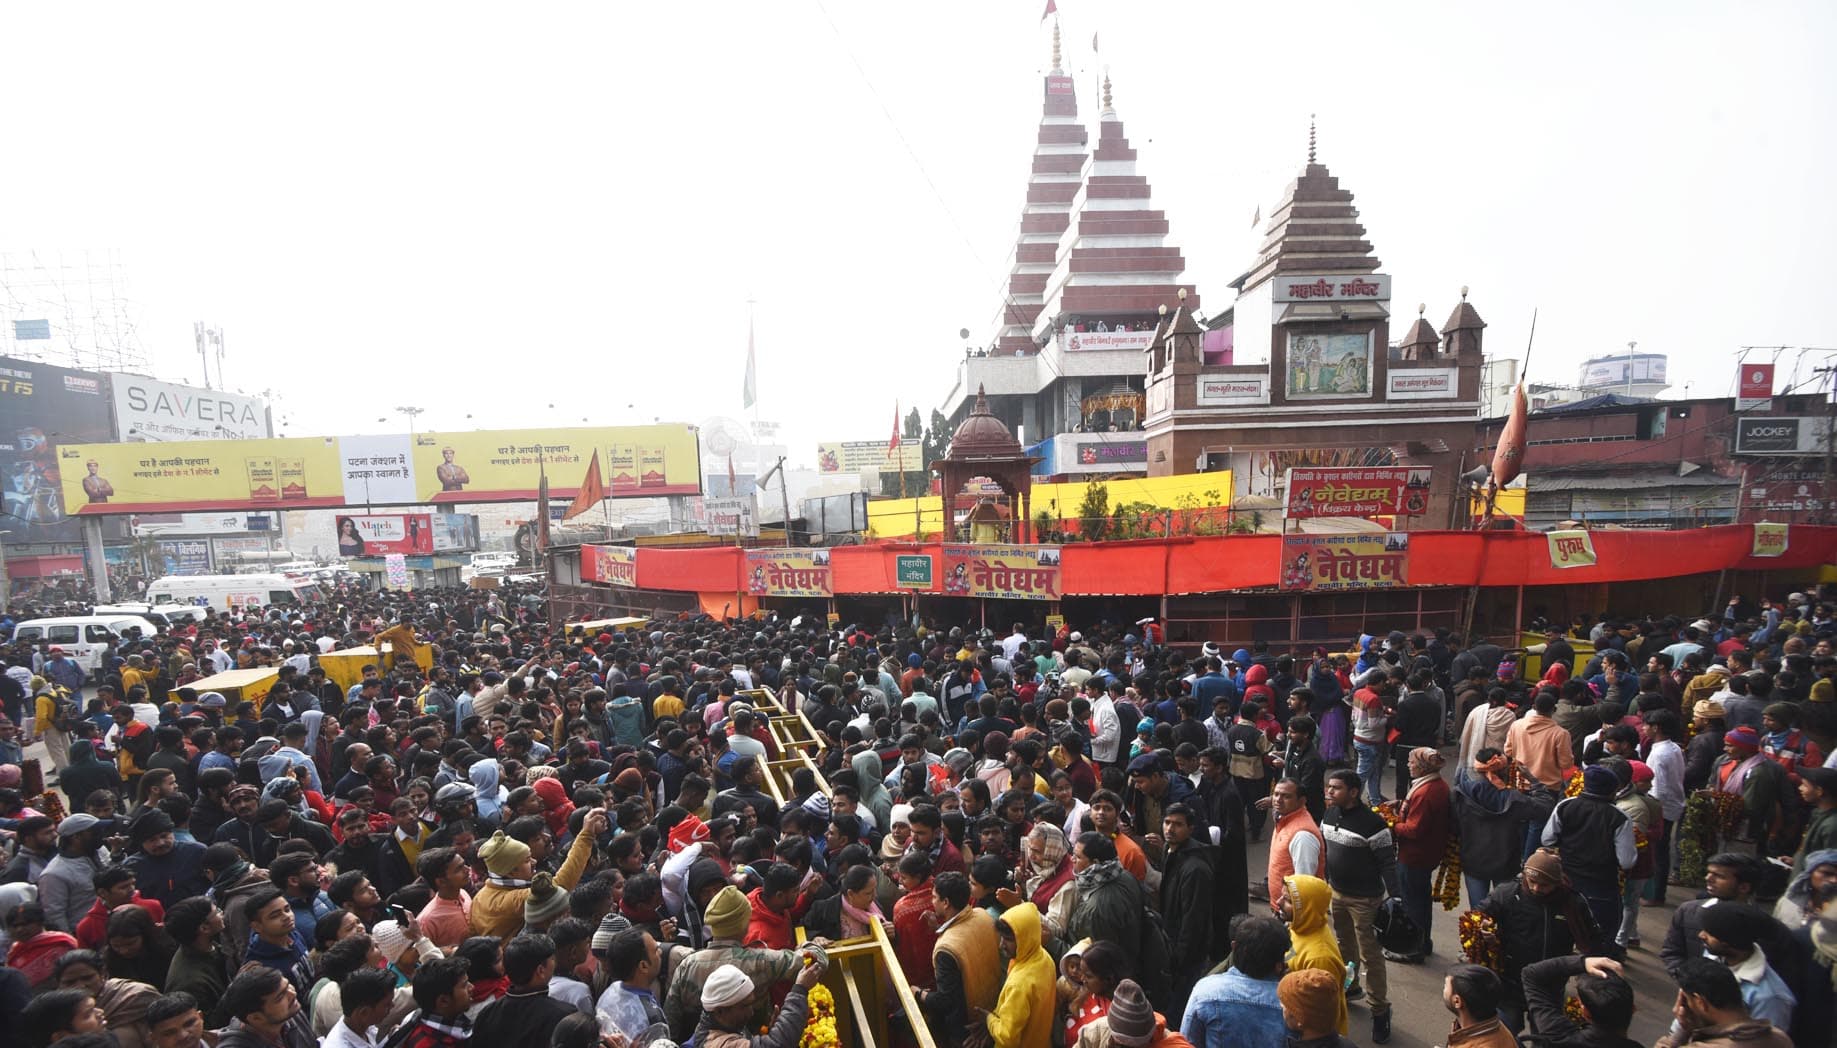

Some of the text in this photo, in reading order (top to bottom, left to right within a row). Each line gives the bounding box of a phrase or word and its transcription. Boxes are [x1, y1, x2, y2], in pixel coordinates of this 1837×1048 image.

[1289, 278, 1335, 298] महावीर
[128, 386, 258, 426] SAVERA
[1746, 427, 1792, 436] JOCKEY
[544, 445, 570, 453] पहचान
[184, 457, 210, 466] पहचान
[348, 458, 368, 466] पटना
[370, 454, 397, 465] जंक्शन
[347, 470, 373, 479] आपका
[375, 469, 401, 478] स्वागत
[901, 558, 927, 568] महावीर
[905, 570, 924, 581] मंदिर
